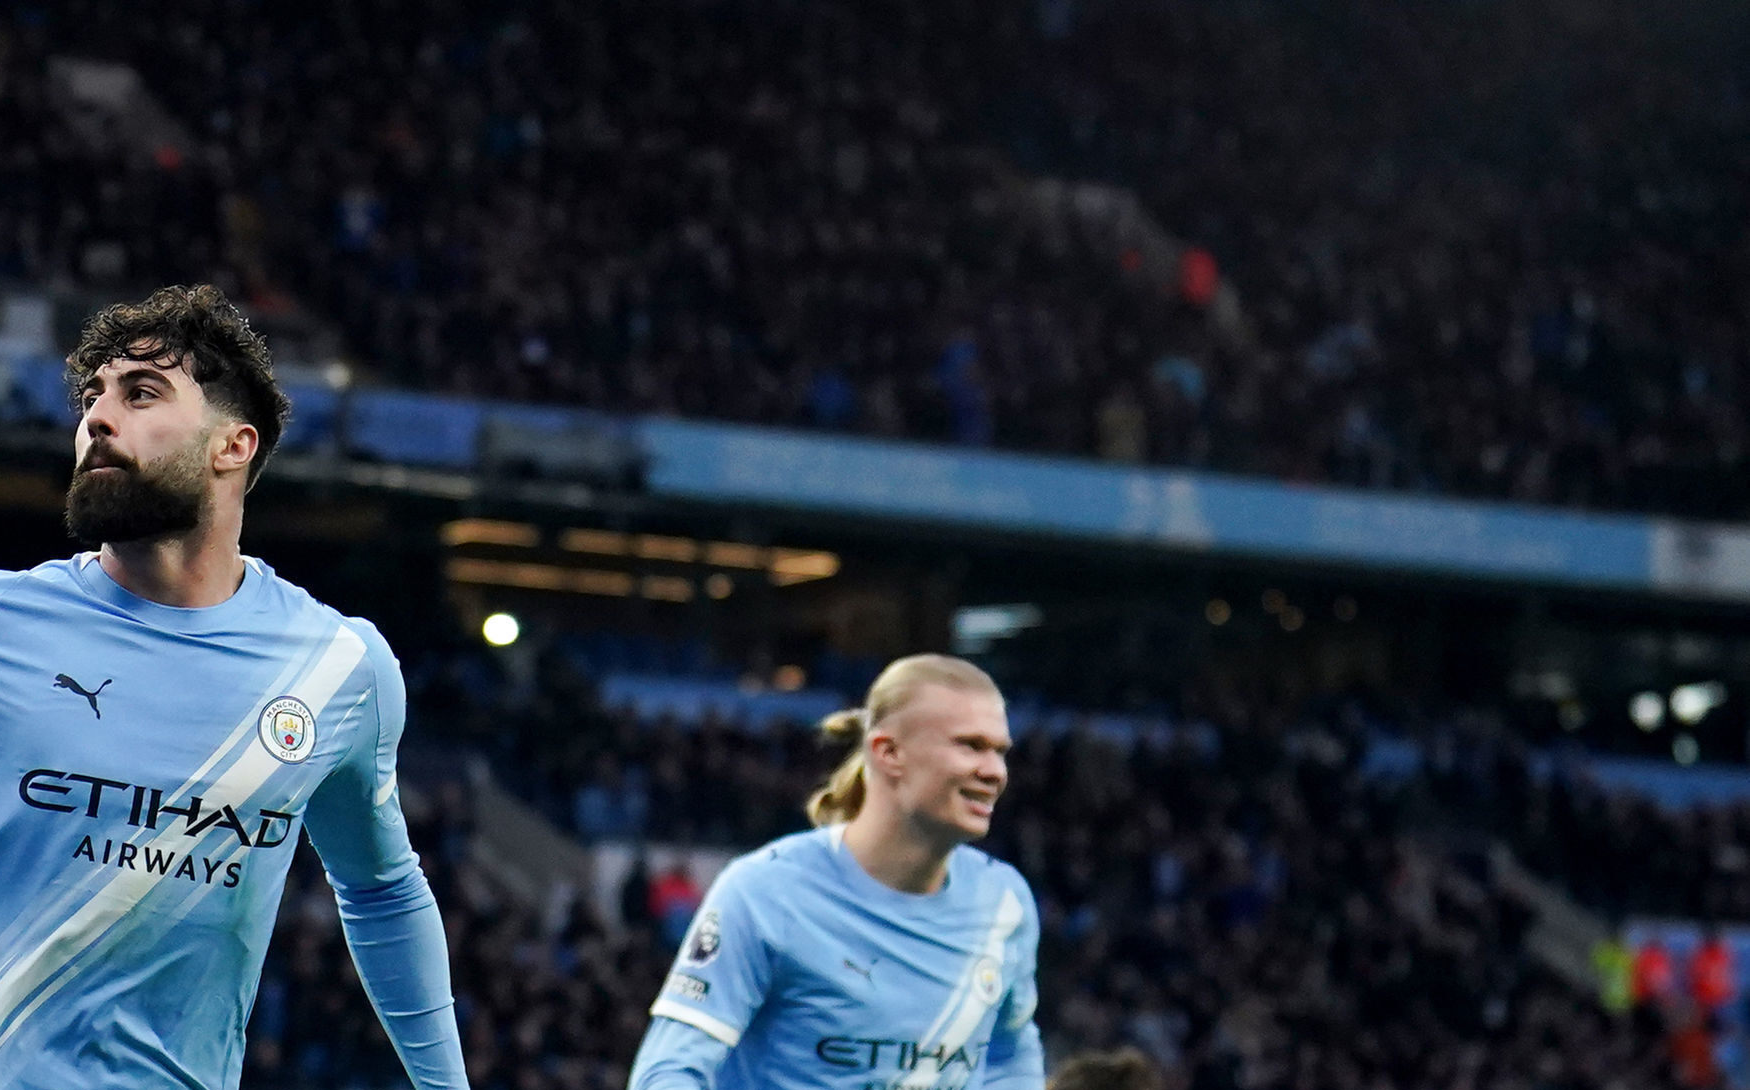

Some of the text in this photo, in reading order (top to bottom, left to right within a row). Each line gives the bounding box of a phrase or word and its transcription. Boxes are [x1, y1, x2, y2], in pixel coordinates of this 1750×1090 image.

[18, 769, 293, 848] ETIHAD
[73, 835, 241, 888] AIRWAYS
[816, 1036, 988, 1072] ETIHA
